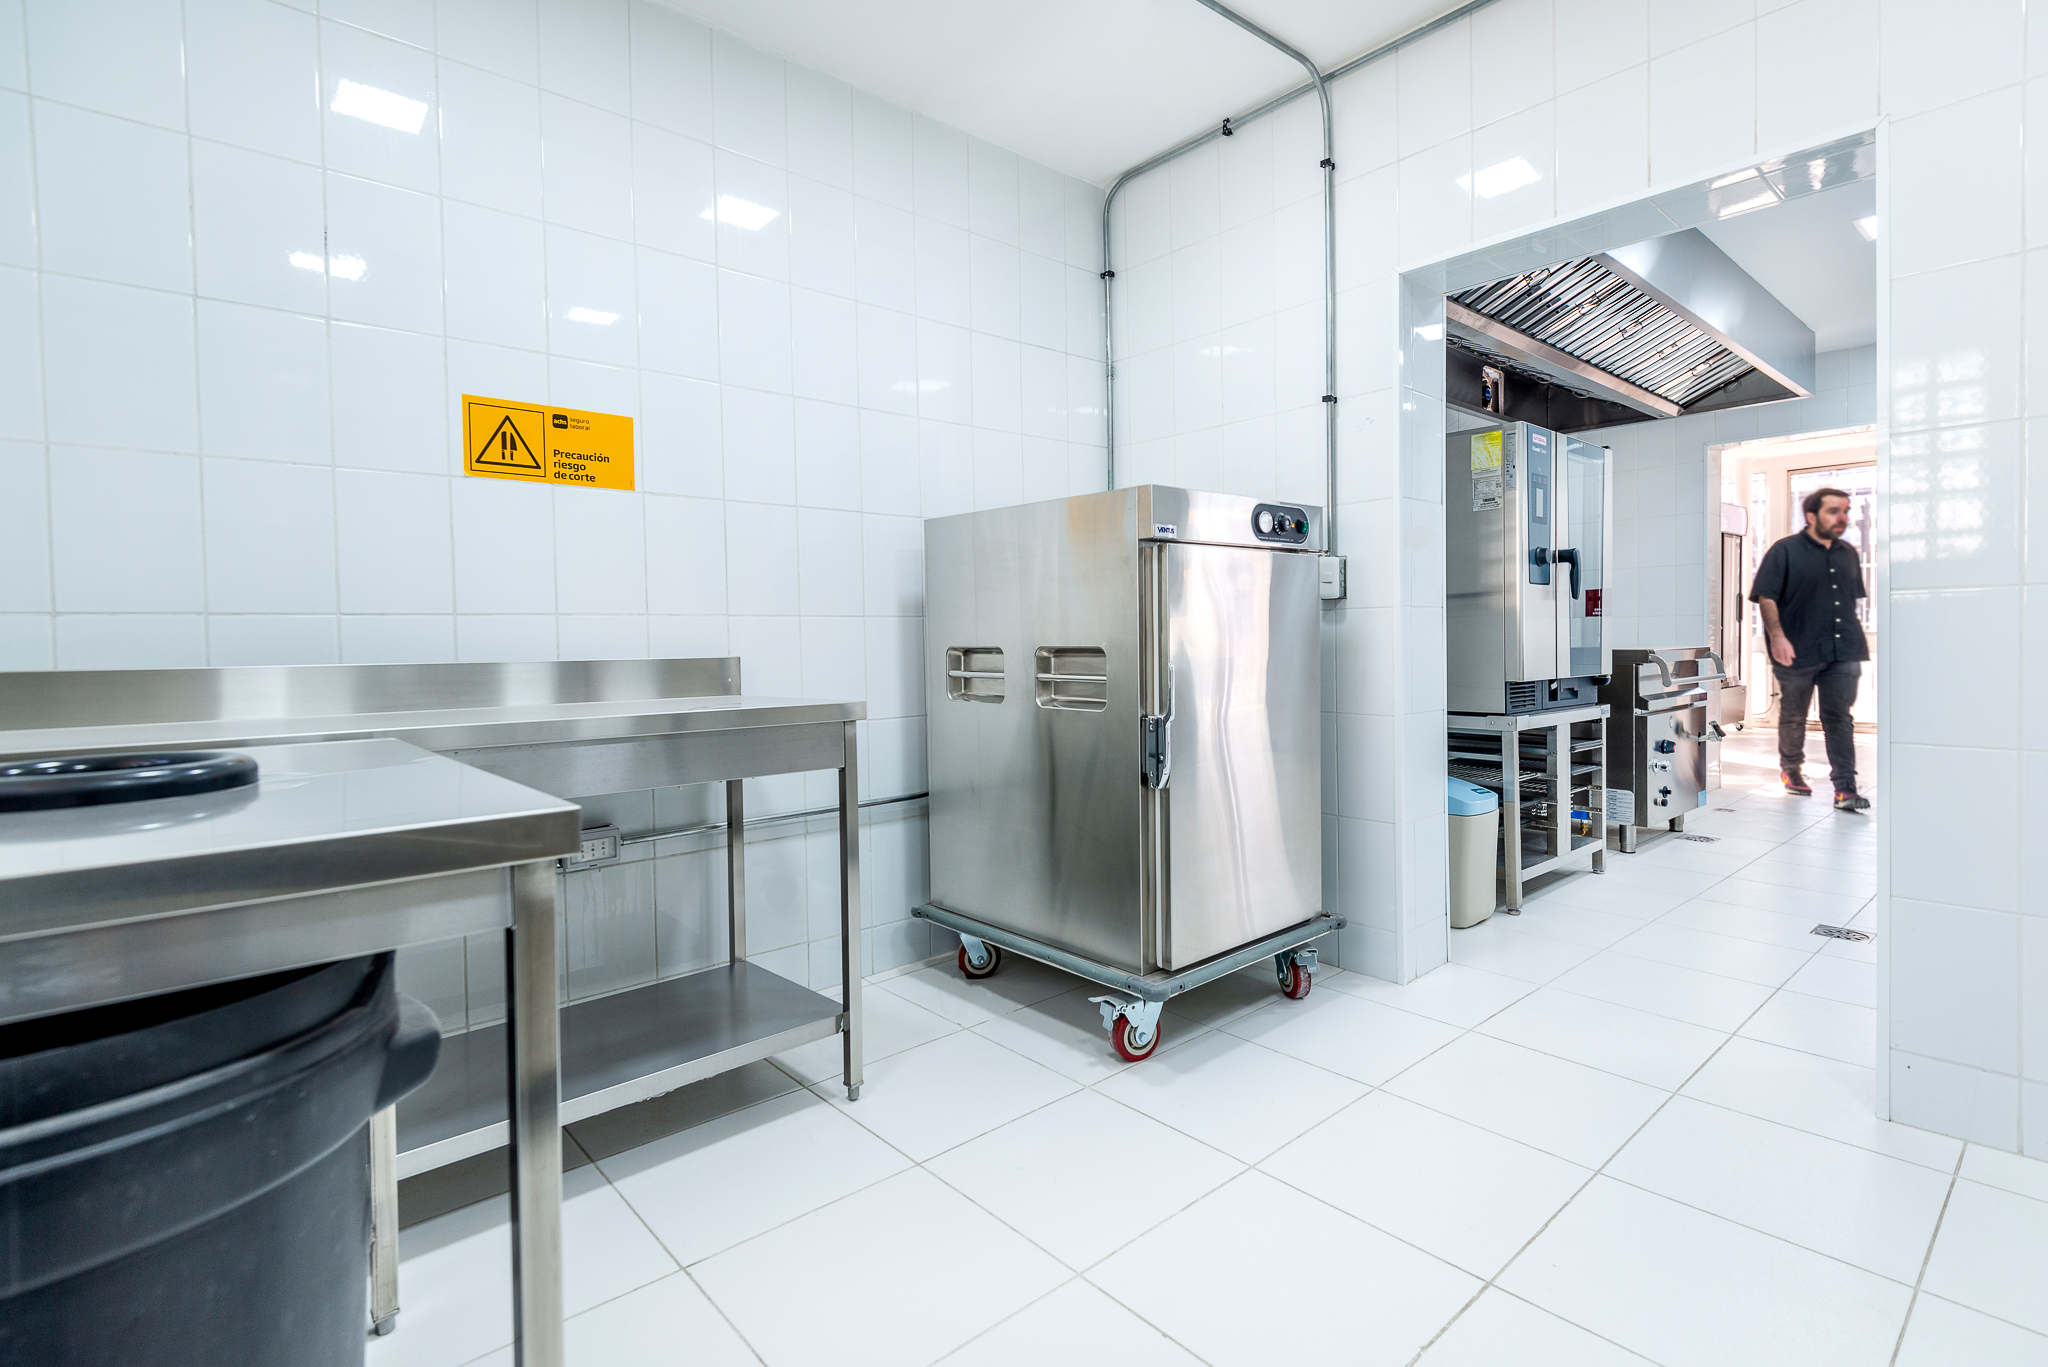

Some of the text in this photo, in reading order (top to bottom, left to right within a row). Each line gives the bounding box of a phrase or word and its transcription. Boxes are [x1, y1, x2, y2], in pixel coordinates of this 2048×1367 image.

[554, 449, 610, 463] Precaución
[554, 460, 586, 472] riesgo
[553, 471, 596, 482] de corte
